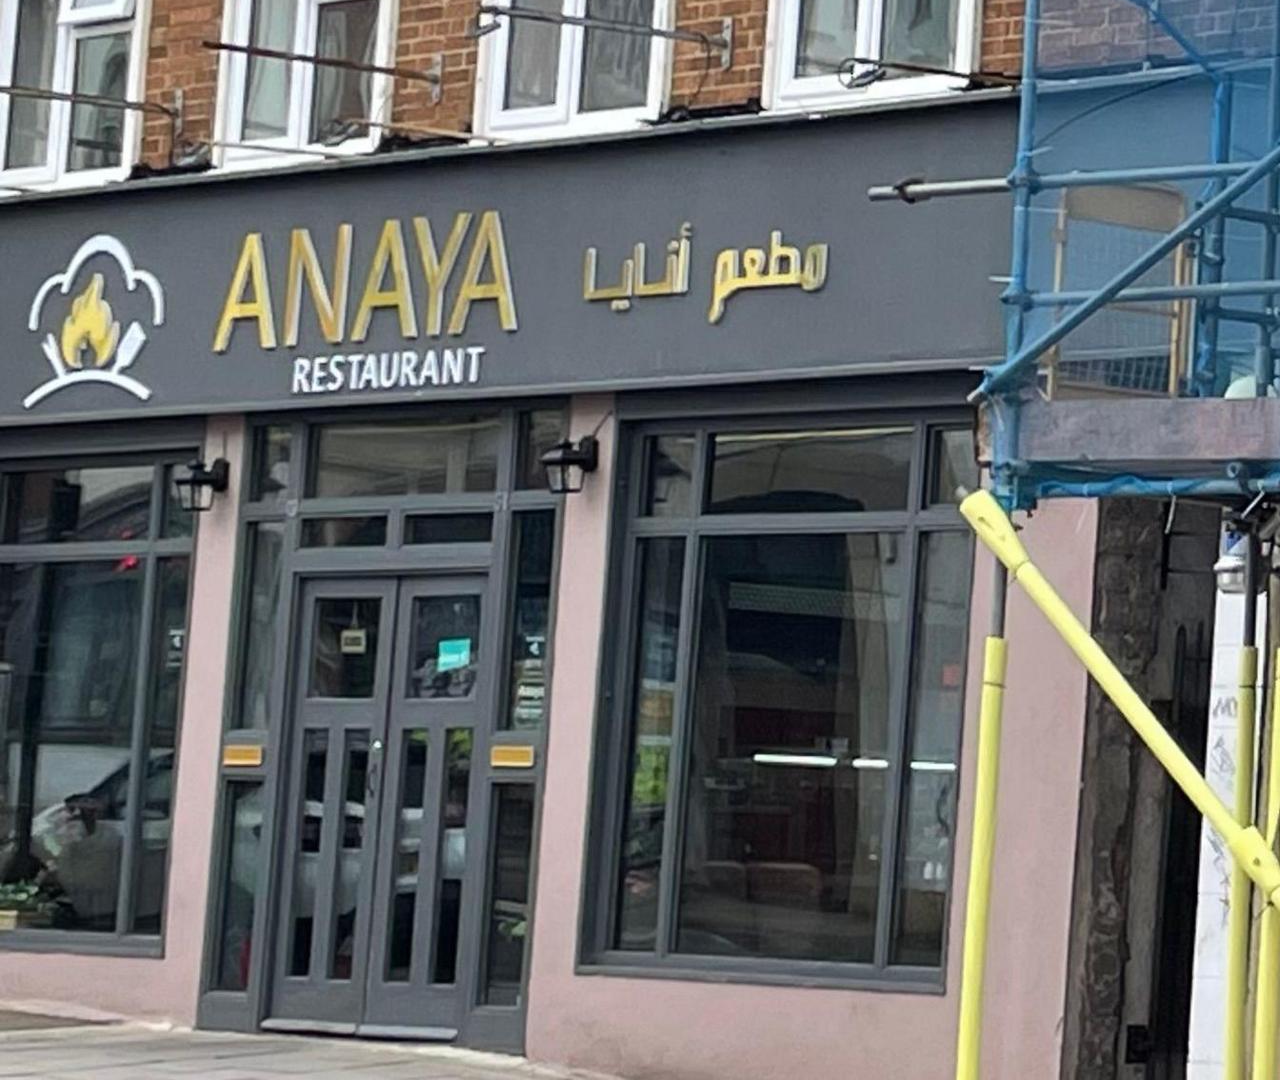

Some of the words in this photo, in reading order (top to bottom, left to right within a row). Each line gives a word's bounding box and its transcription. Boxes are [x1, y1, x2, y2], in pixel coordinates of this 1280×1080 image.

[213, 210, 518, 353] ANAYA
[708, 229, 829, 324] مطعم
[291, 346, 486, 394] RESTAURANT
